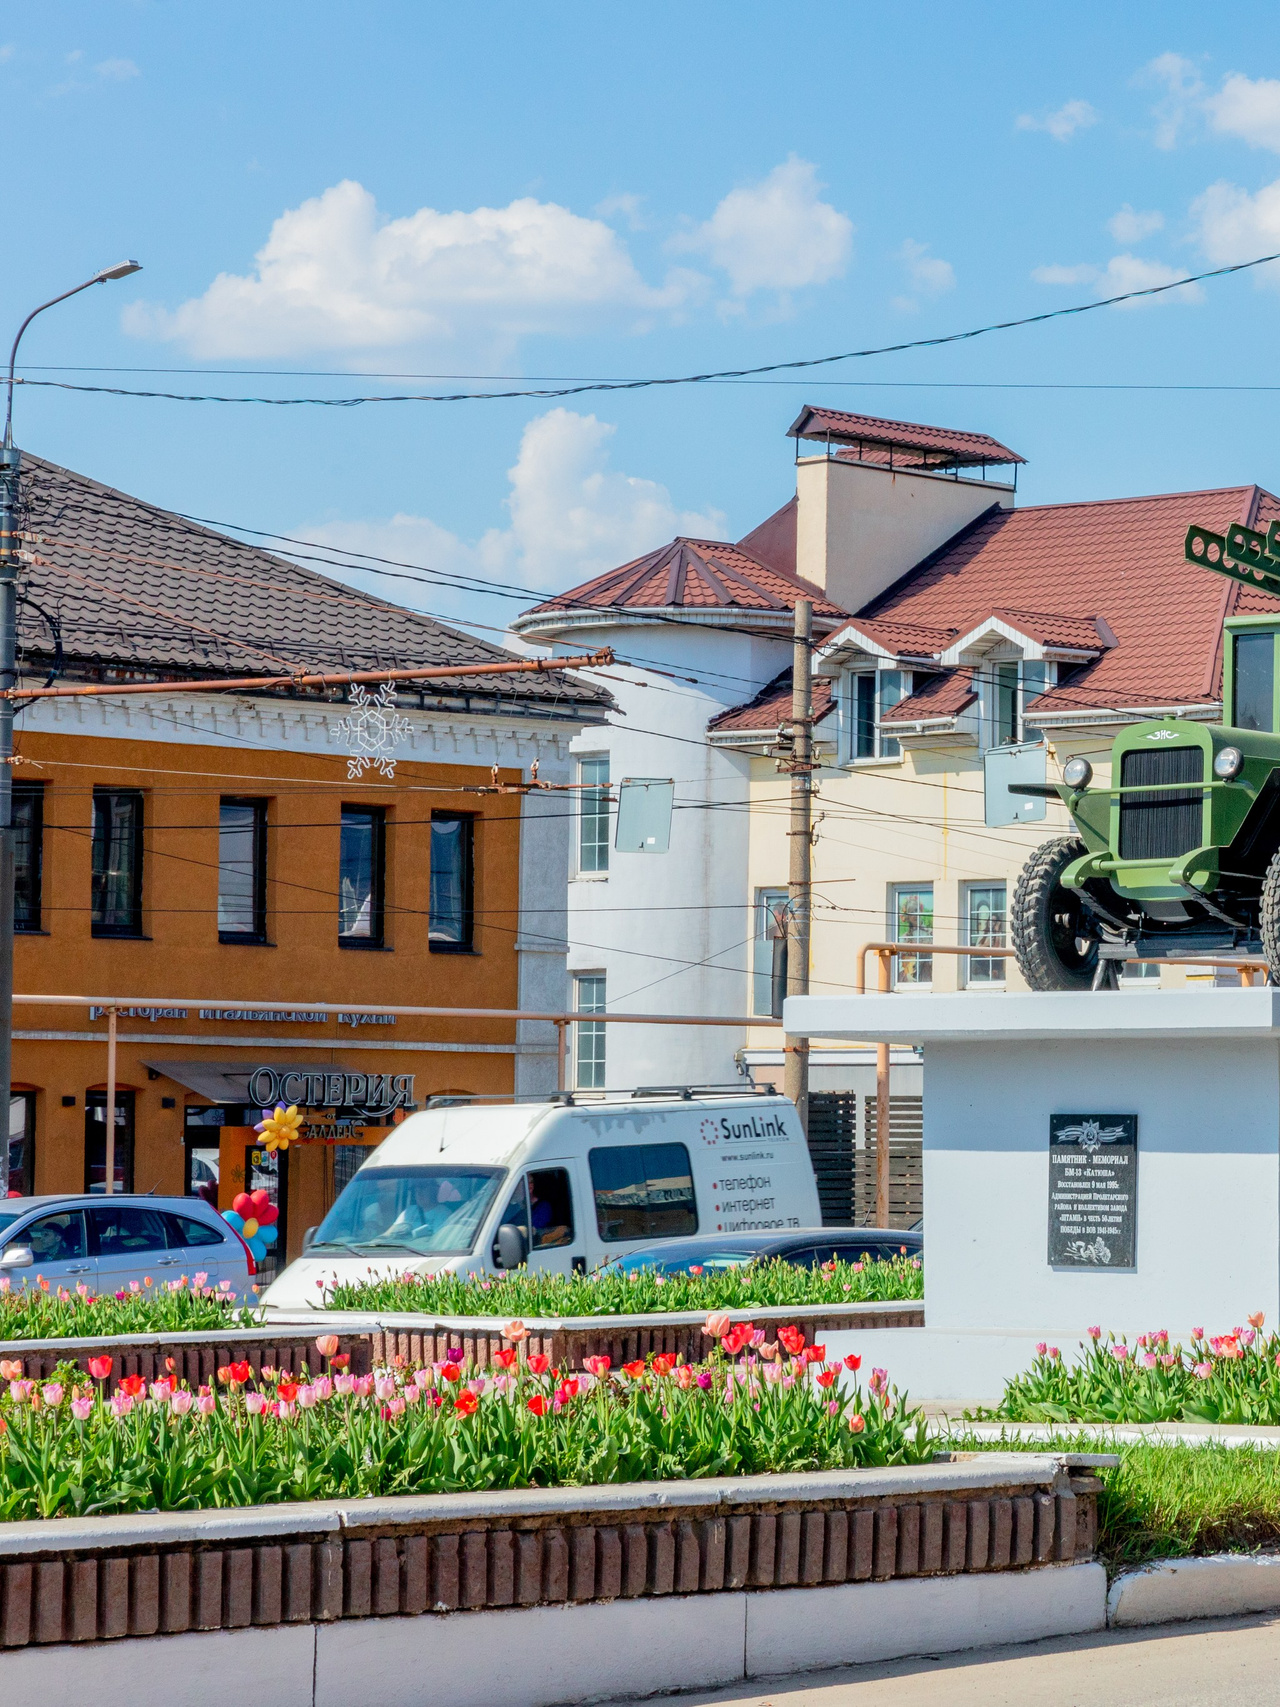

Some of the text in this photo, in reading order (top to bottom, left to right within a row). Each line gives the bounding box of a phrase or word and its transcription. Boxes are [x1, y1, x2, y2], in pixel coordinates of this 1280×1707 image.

[721, 1114, 788, 1140] SunLink
[721, 1151, 774, 1161] www.sunlink.ru
[1052, 1154, 1087, 1164] ПАМЯТНИК
[1092, 1155, 1129, 1165] МЕМОРИАЛ
[1064, 1168, 1082, 1177] БМ-13
[719, 1174, 771, 1193] телефон
[722, 1198, 776, 1215] интернет
[1060, 1225, 1082, 1235] ПОБЕДЫ
